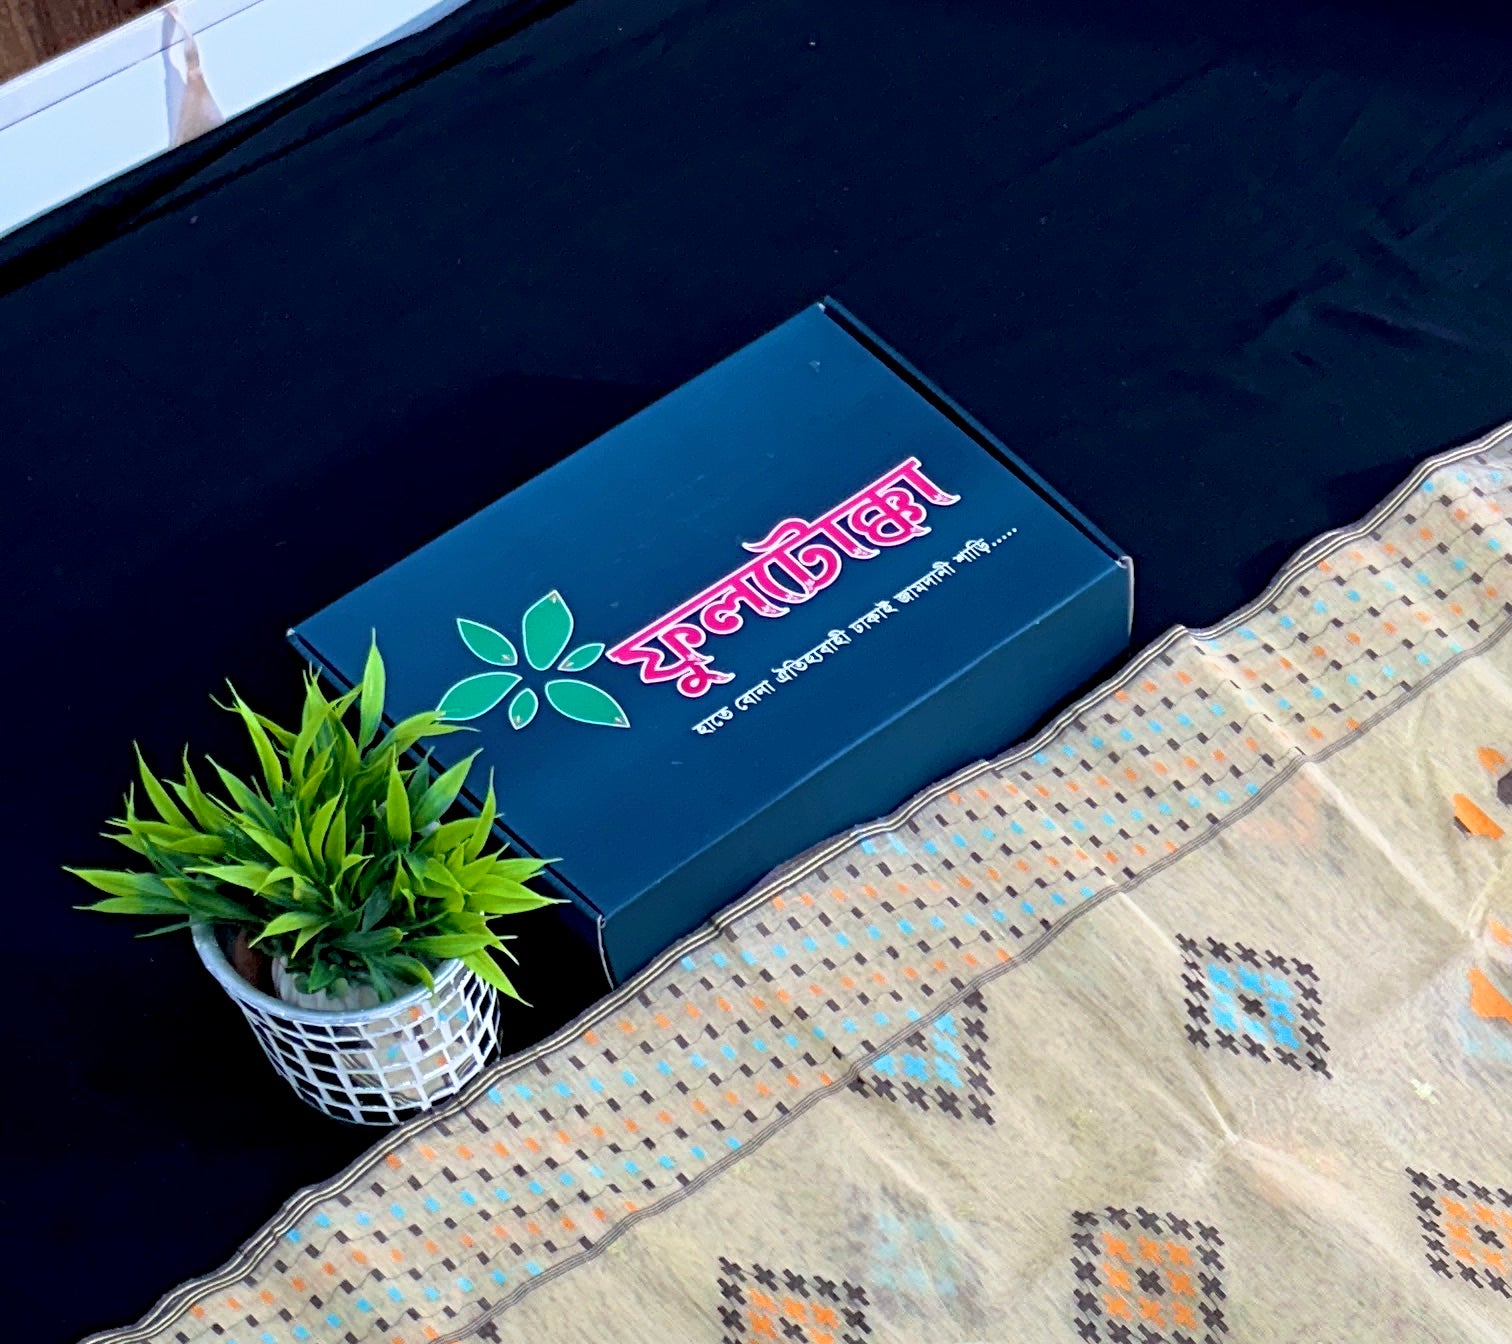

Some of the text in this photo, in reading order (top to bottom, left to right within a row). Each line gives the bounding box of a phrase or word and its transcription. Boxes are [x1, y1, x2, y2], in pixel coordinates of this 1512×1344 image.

[691, 706, 734, 735] হাতে
[734, 679, 776, 711] বোনা
[771, 629, 852, 683] ঐতিহ্যবাহী
[848, 600, 899, 634] ঢাকাই
[893, 561, 956, 603] জামদানী
